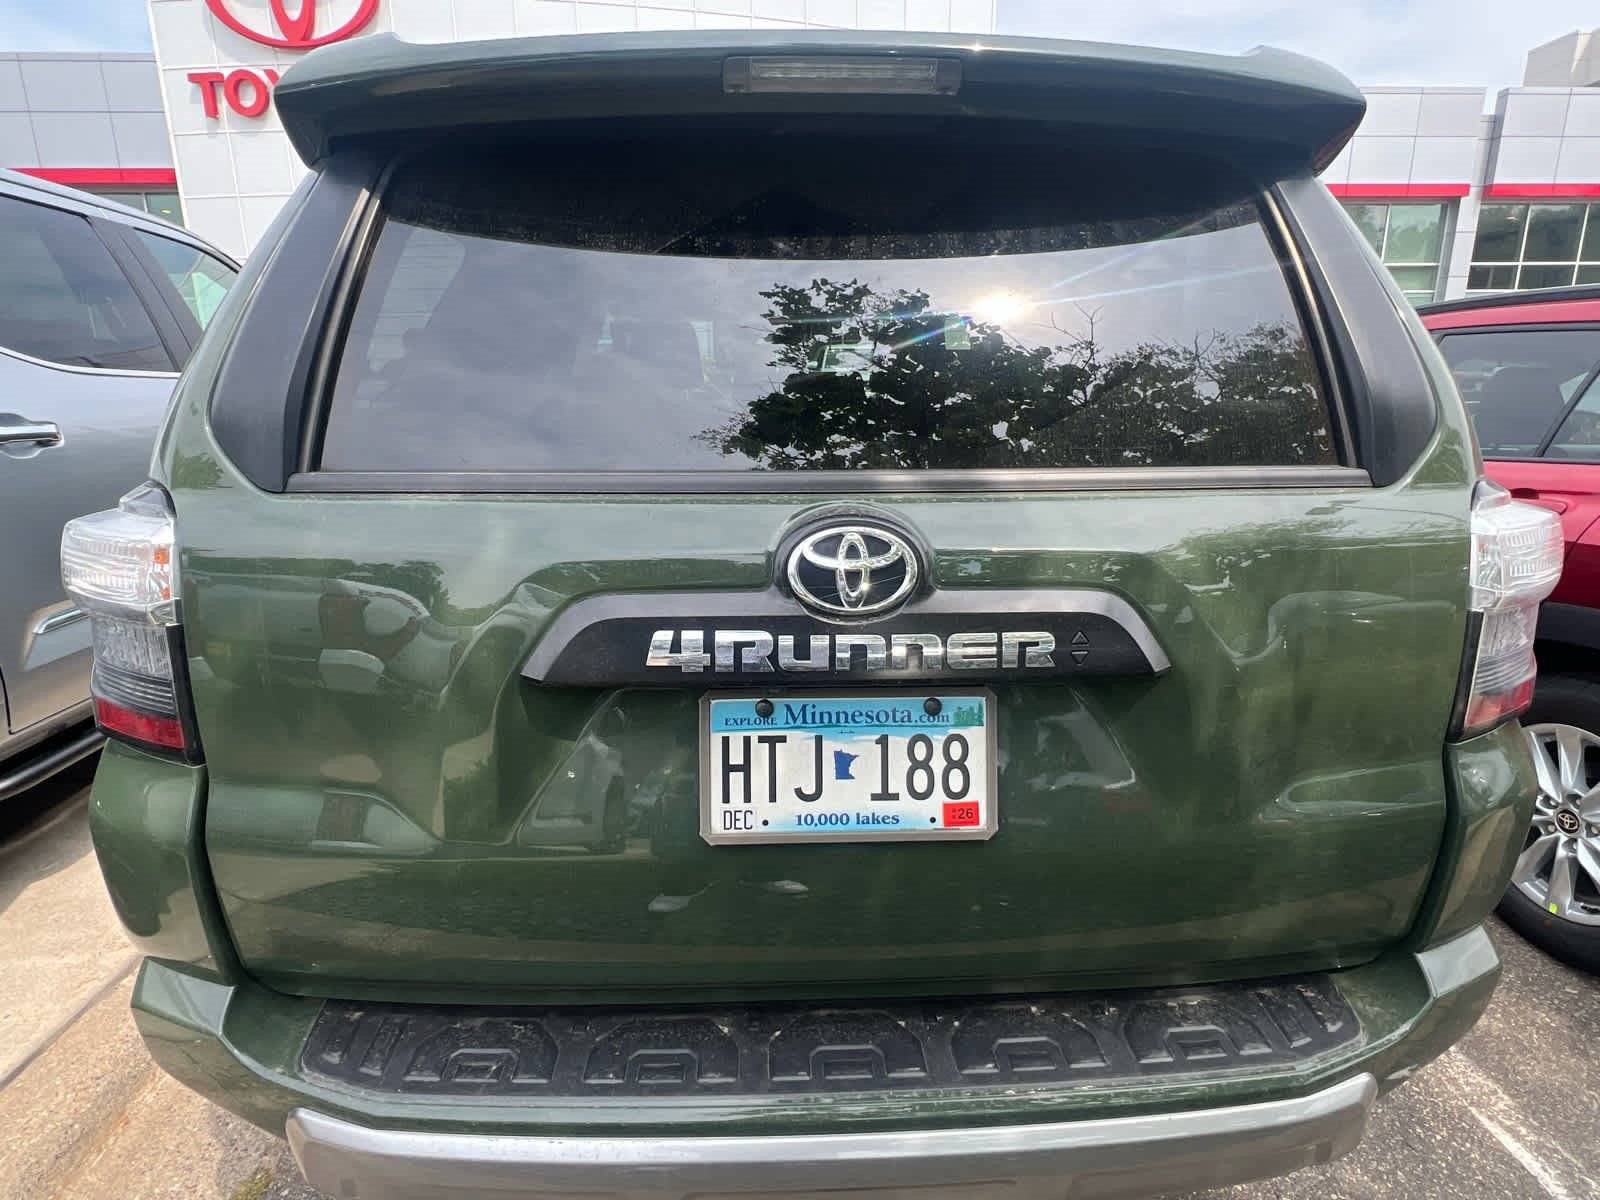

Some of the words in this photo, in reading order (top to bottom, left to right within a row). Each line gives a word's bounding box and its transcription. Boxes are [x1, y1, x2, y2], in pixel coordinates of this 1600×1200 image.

[646, 629, 1057, 674] 4RUNNER
[724, 717, 777, 727] EXPLORE
[721, 734, 824, 803] HTJ
[870, 733, 970, 801] 188
[723, 810, 753, 831] DEC
[795, 813, 850, 827] 10,000
[856, 812, 900, 826] lakes
[957, 807, 974, 820] 26
